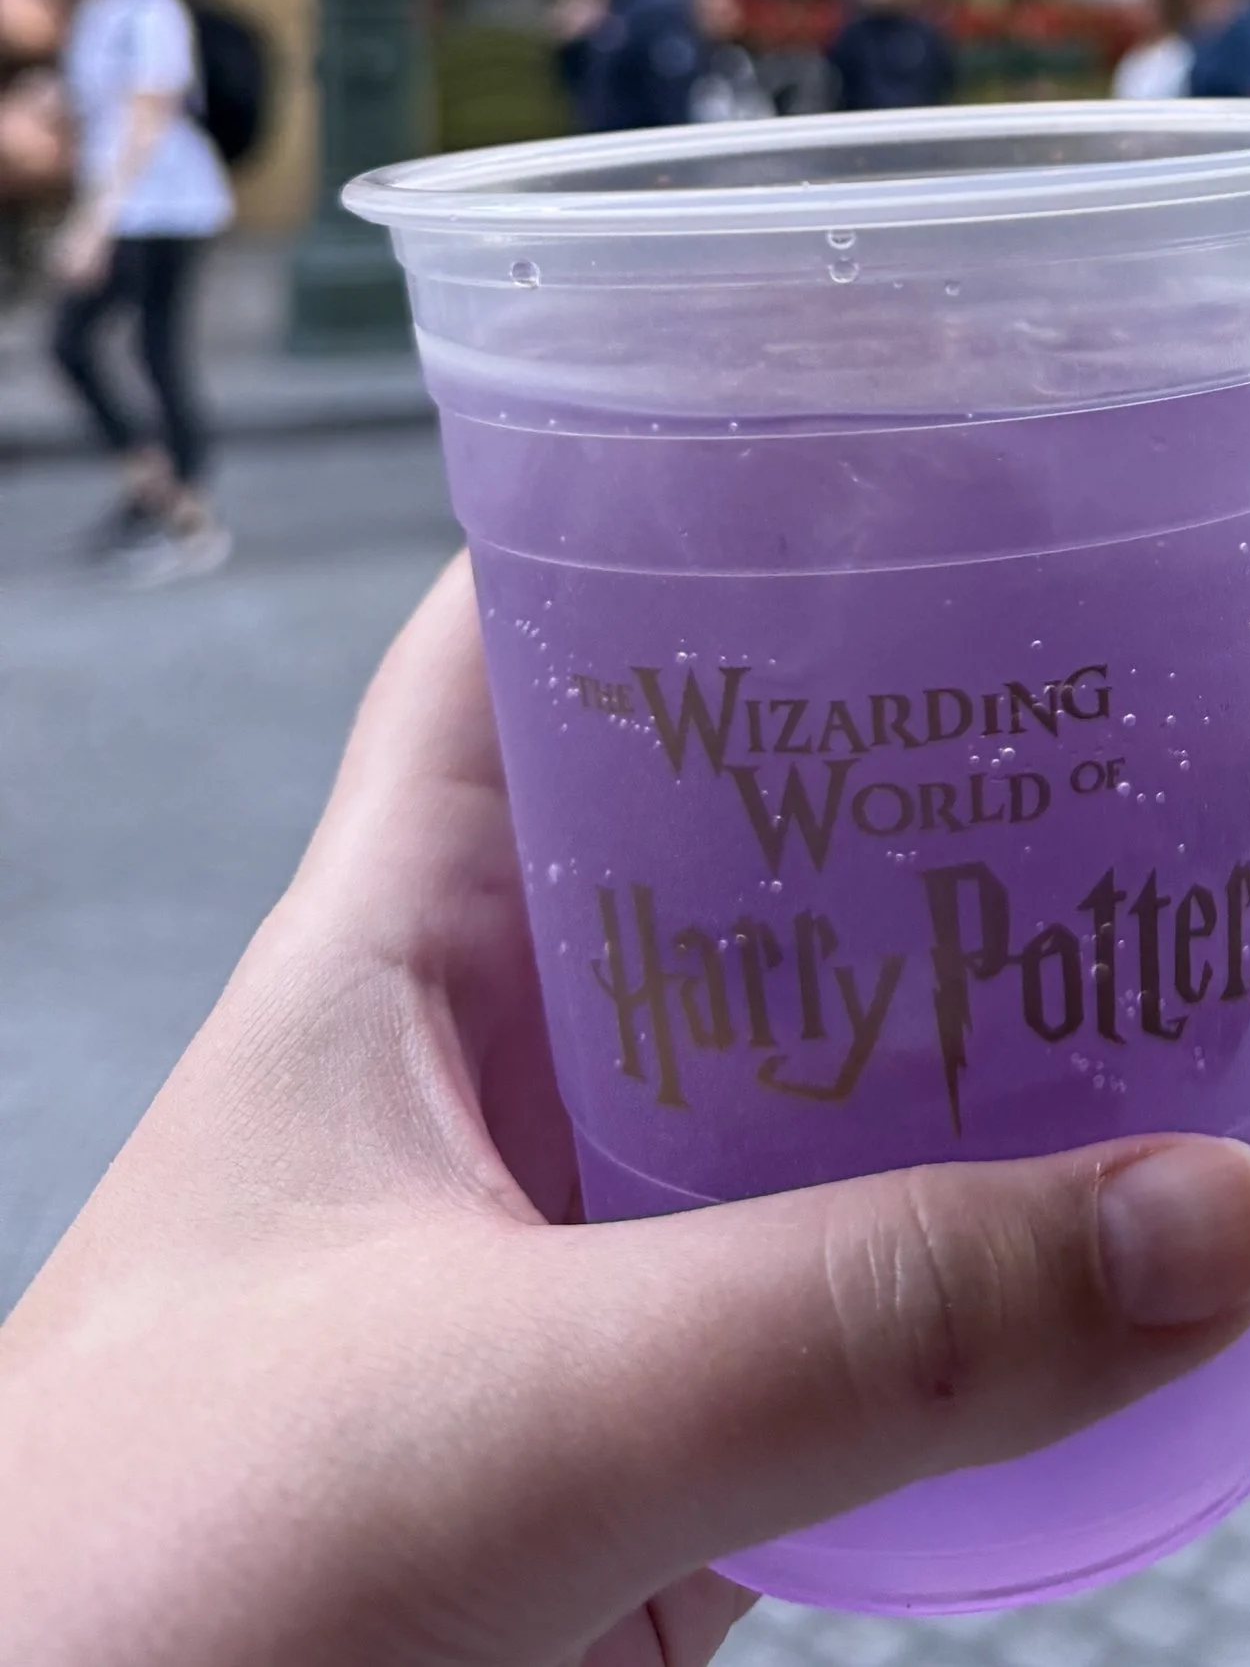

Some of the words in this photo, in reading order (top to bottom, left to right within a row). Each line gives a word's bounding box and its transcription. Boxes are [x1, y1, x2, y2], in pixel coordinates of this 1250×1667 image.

[573, 672, 635, 715] THE
[629, 665, 1112, 778] WIZARDING
[722, 757, 1051, 881] WORLD
[1070, 757, 1126, 795] OF
[591, 881, 906, 1109] Harry
